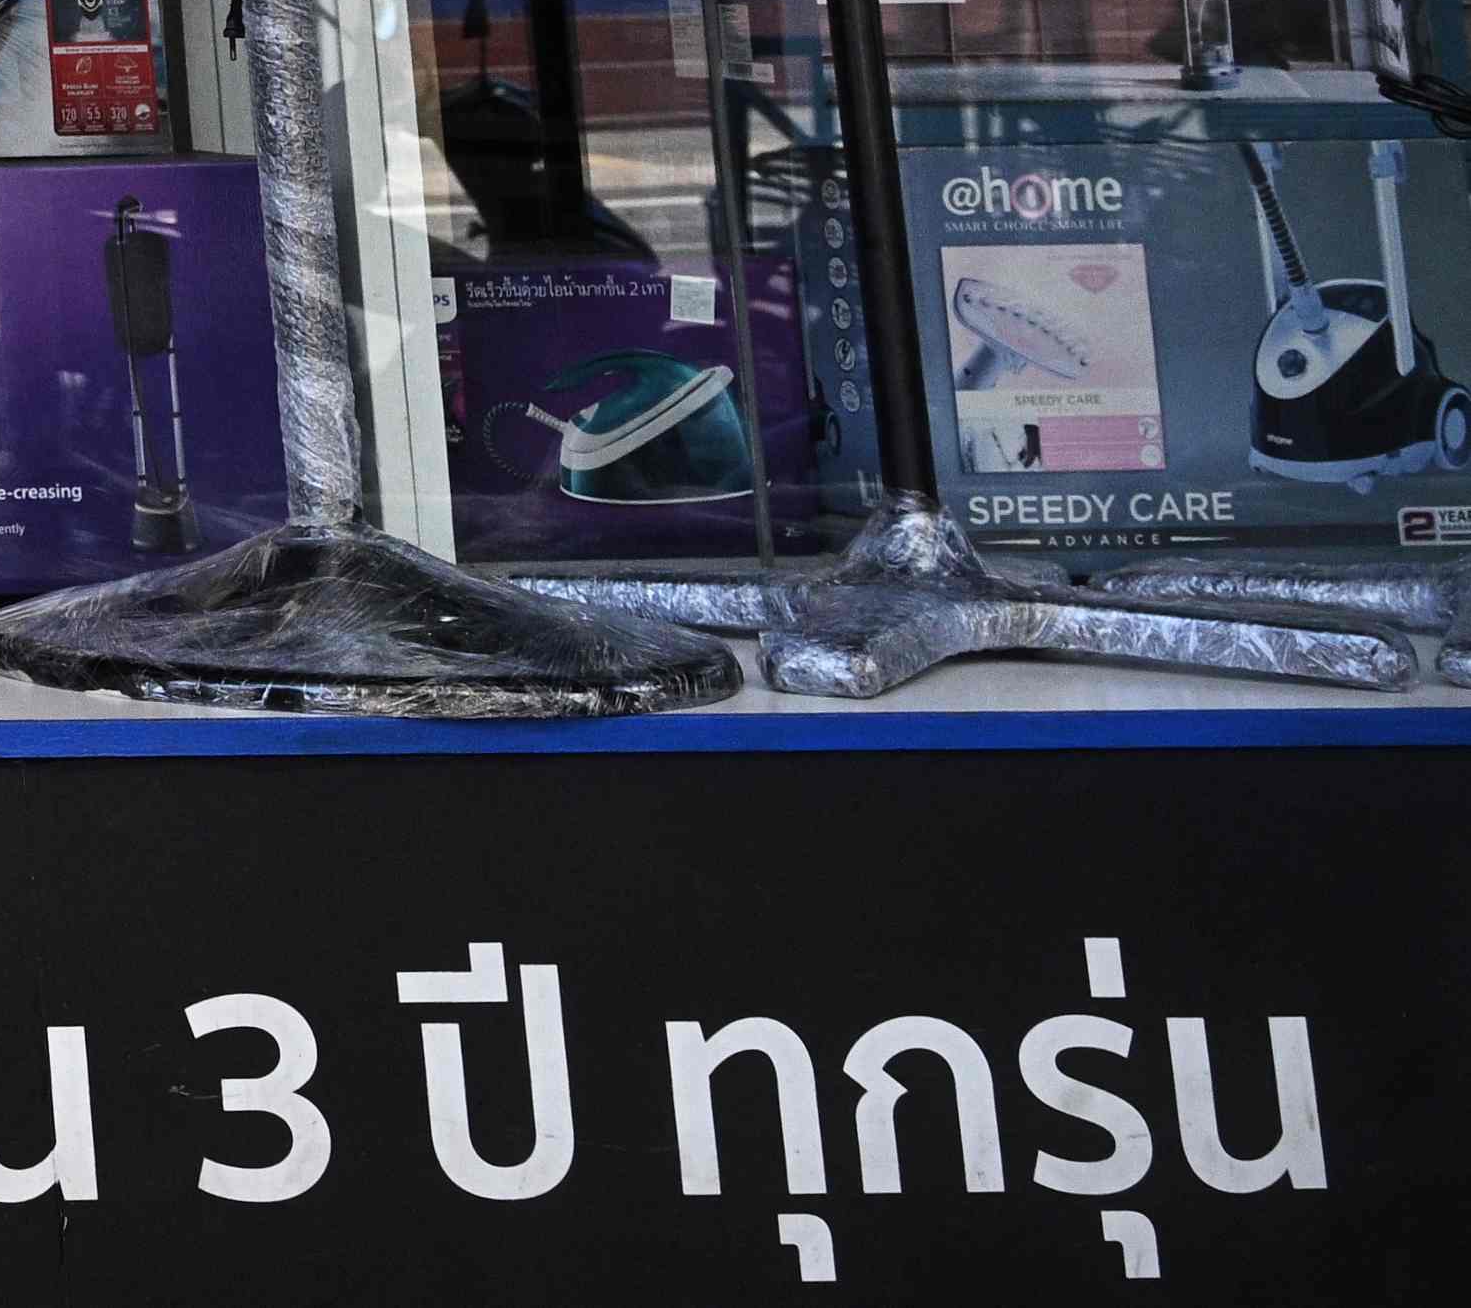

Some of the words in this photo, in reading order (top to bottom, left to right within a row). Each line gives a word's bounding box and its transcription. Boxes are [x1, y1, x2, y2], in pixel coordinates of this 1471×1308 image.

[942, 165, 1123, 219] @home
[945, 221, 987, 233] SMART
[630, 281, 638, 296] 2
[1014, 394, 1062, 406] SPEEDY
[1067, 394, 1103, 405] CARE
[969, 493, 1116, 526] SPEEDY
[1130, 492, 1236, 523] CARE
[1402, 511, 1436, 542] 2
[1048, 535, 1162, 548] ADVANCE
[182, 989, 334, 1206] 3
[395, 941, 578, 1206] ปี
[663, 935, 1331, 1283] ทุกรุ่น
